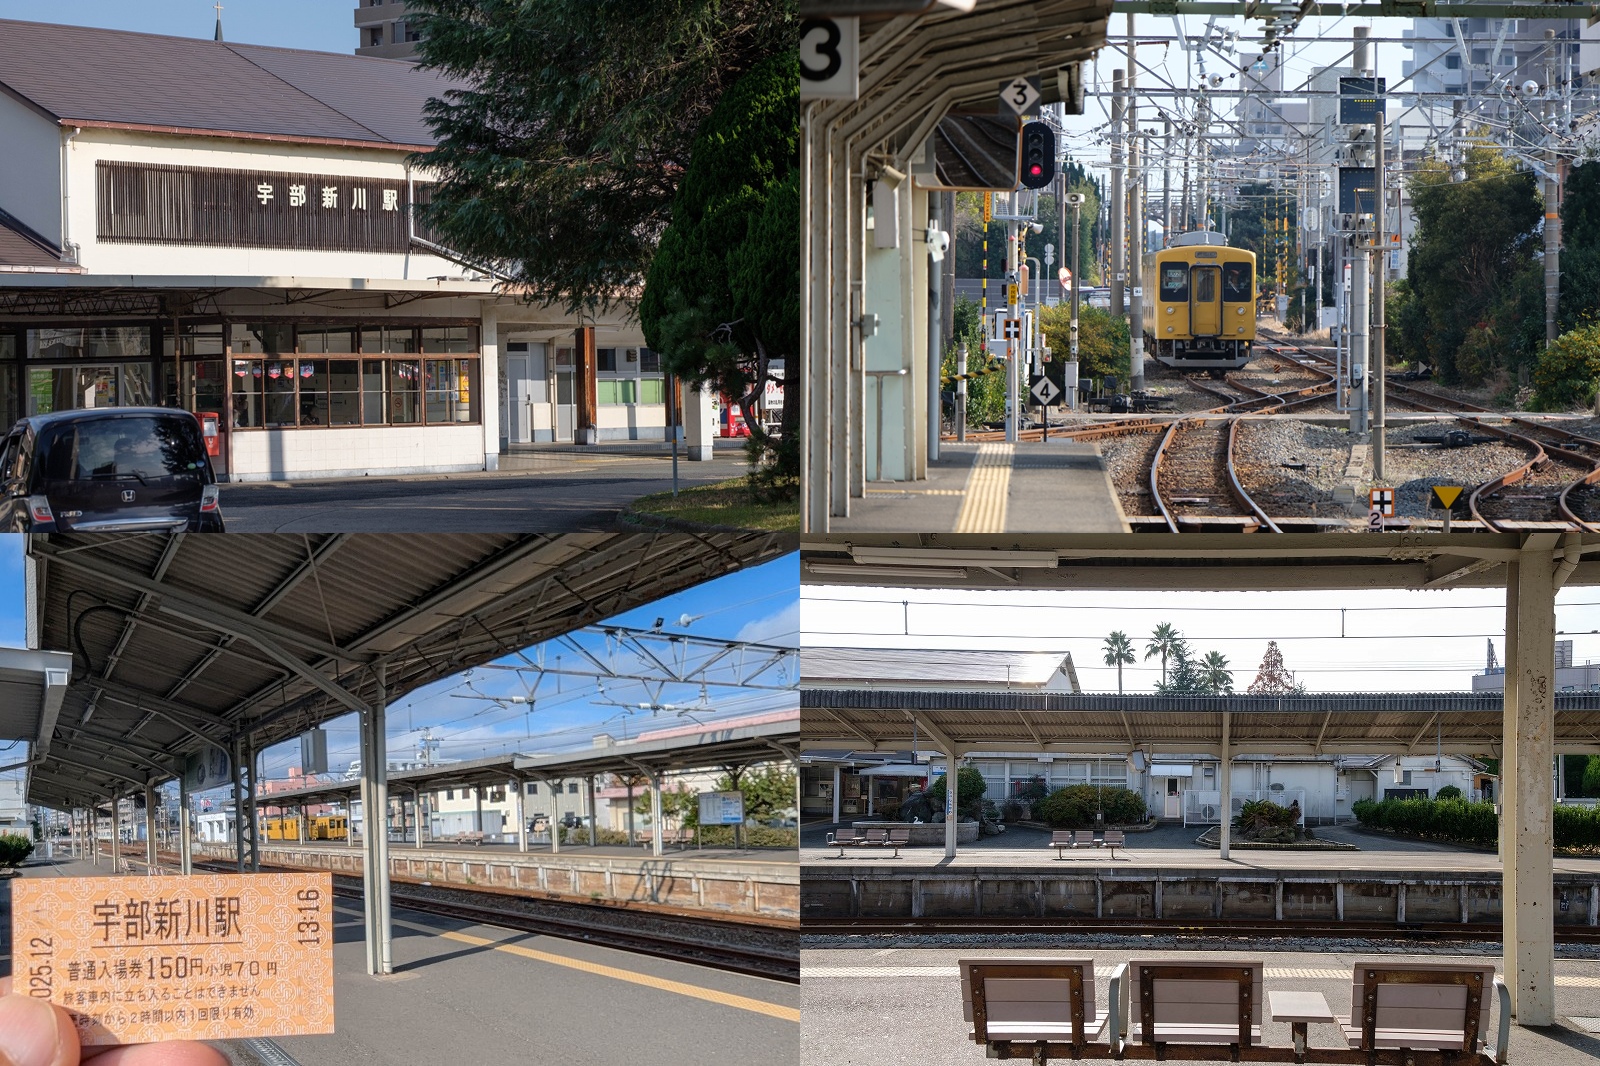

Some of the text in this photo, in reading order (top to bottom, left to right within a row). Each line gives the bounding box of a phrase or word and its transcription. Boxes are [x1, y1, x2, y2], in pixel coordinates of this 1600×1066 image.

[800, 17, 842, 82] 3
[1012, 84, 1028, 106] 3
[257, 182, 398, 211] 宇部新川駅
[1039, 383, 1051, 399] 4
[1370, 512, 1380, 526] 2
[93, 897, 242, 942] 宇部新川駅
[297, 889, 321, 946] 13:16
[29, 937, 53, 1000] 025.12
